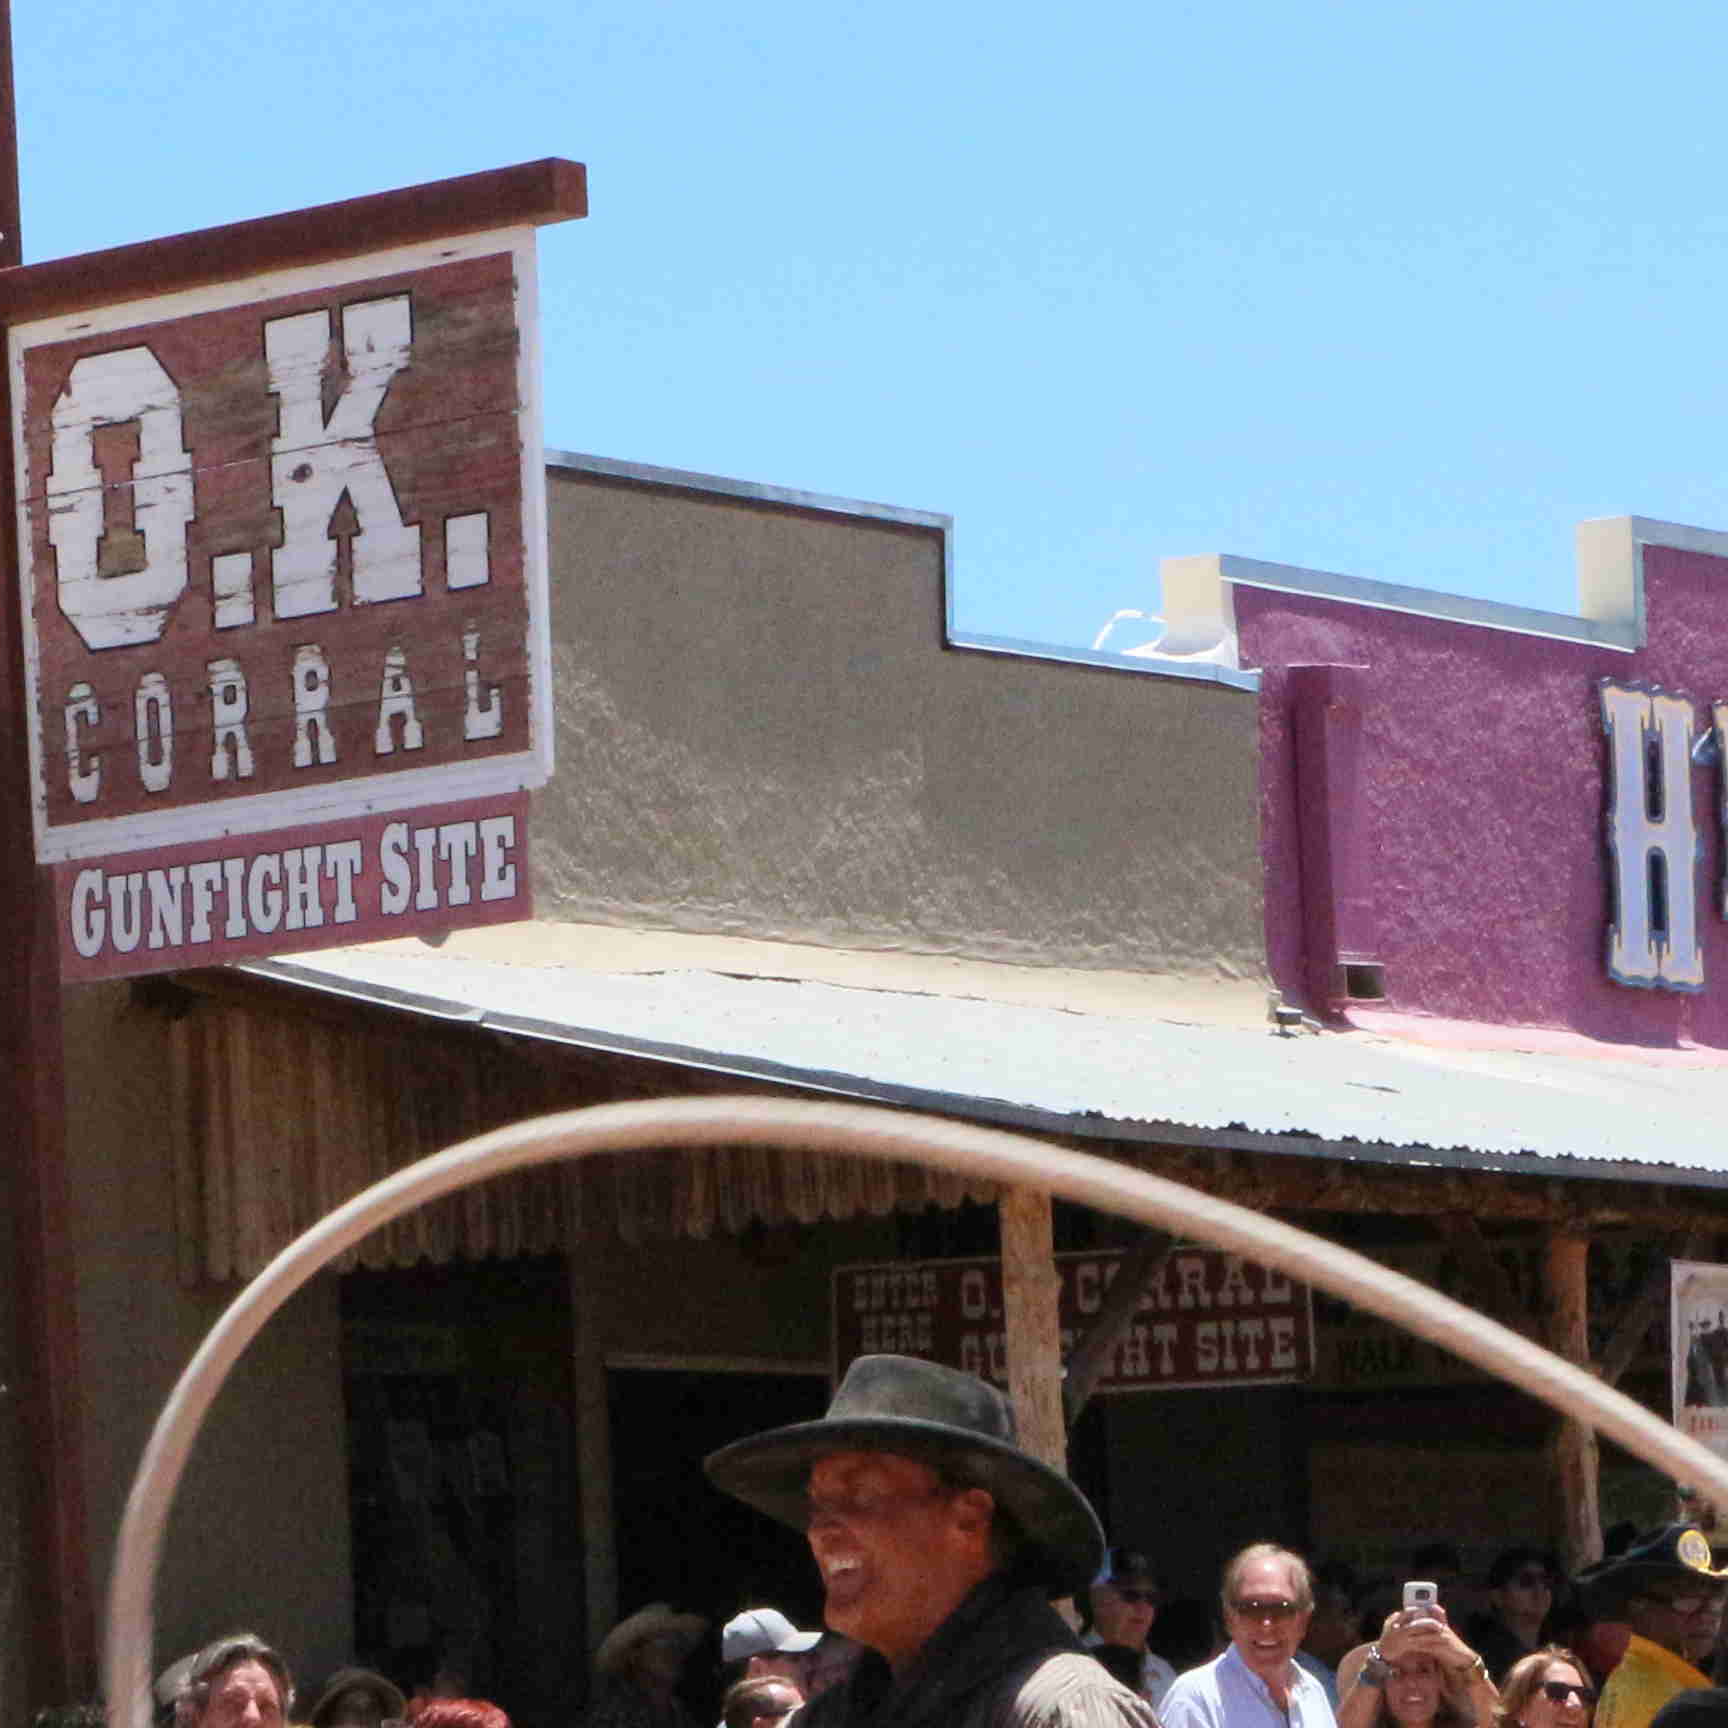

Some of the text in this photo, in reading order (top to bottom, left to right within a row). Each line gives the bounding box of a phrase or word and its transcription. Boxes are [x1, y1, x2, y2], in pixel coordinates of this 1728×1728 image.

[47, 290, 490, 653] O.K.
[64, 621, 504, 804] CORRAL
[72, 814, 517, 958] GUNFIGHT SITE
[1075, 1255, 1292, 1313] CRRAL
[1196, 1315, 1297, 1373] SITE
